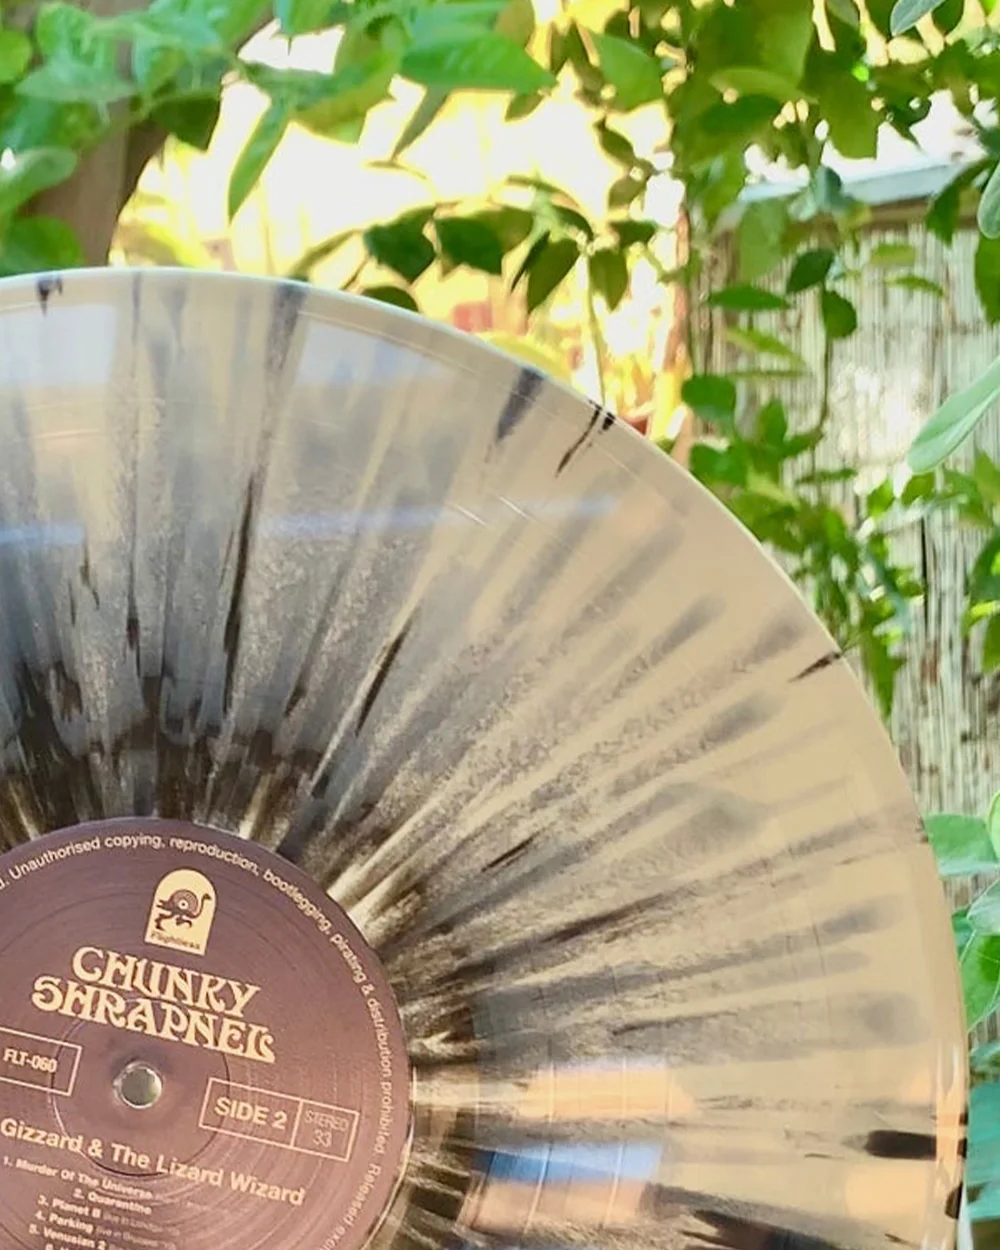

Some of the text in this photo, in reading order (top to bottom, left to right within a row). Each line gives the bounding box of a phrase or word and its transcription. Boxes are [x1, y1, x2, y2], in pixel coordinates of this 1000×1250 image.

[9, 837, 101, 880] Unauthorised
[170, 837, 259, 877] reproduction,
[330, 933, 367, 983] pirating
[72, 946, 260, 1018] CHUNKY
[361, 984, 375, 996] &
[31, 975, 276, 1064] SHRAPNEL
[367, 998, 392, 1078] distribution
[3, 1048, 58, 1073] FLT-060
[215, 1097, 288, 1130] SIDE 2
[303, 1110, 349, 1132] STEREO
[0, 1118, 83, 1151] Gizzard
[88, 1139, 103, 1159] &
[111, 1143, 150, 1169] The
[156, 1157, 222, 1188] Lizard
[230, 1171, 306, 1206] Wizard
[16, 1158, 58, 1177] Murder
[61, 1169, 75, 1182] Of
[78, 1174, 99, 1187] The
[102, 1176, 153, 1199] Universe
[37, 1195, 48, 1206] 3.
[52, 1198, 90, 1217] Planet
[88, 1191, 152, 1215] Quarantine
[345, 1163, 381, 1227] Released
[43, 1227, 95, 1249] Venusian
[48, 1212, 94, 1233] Parking
